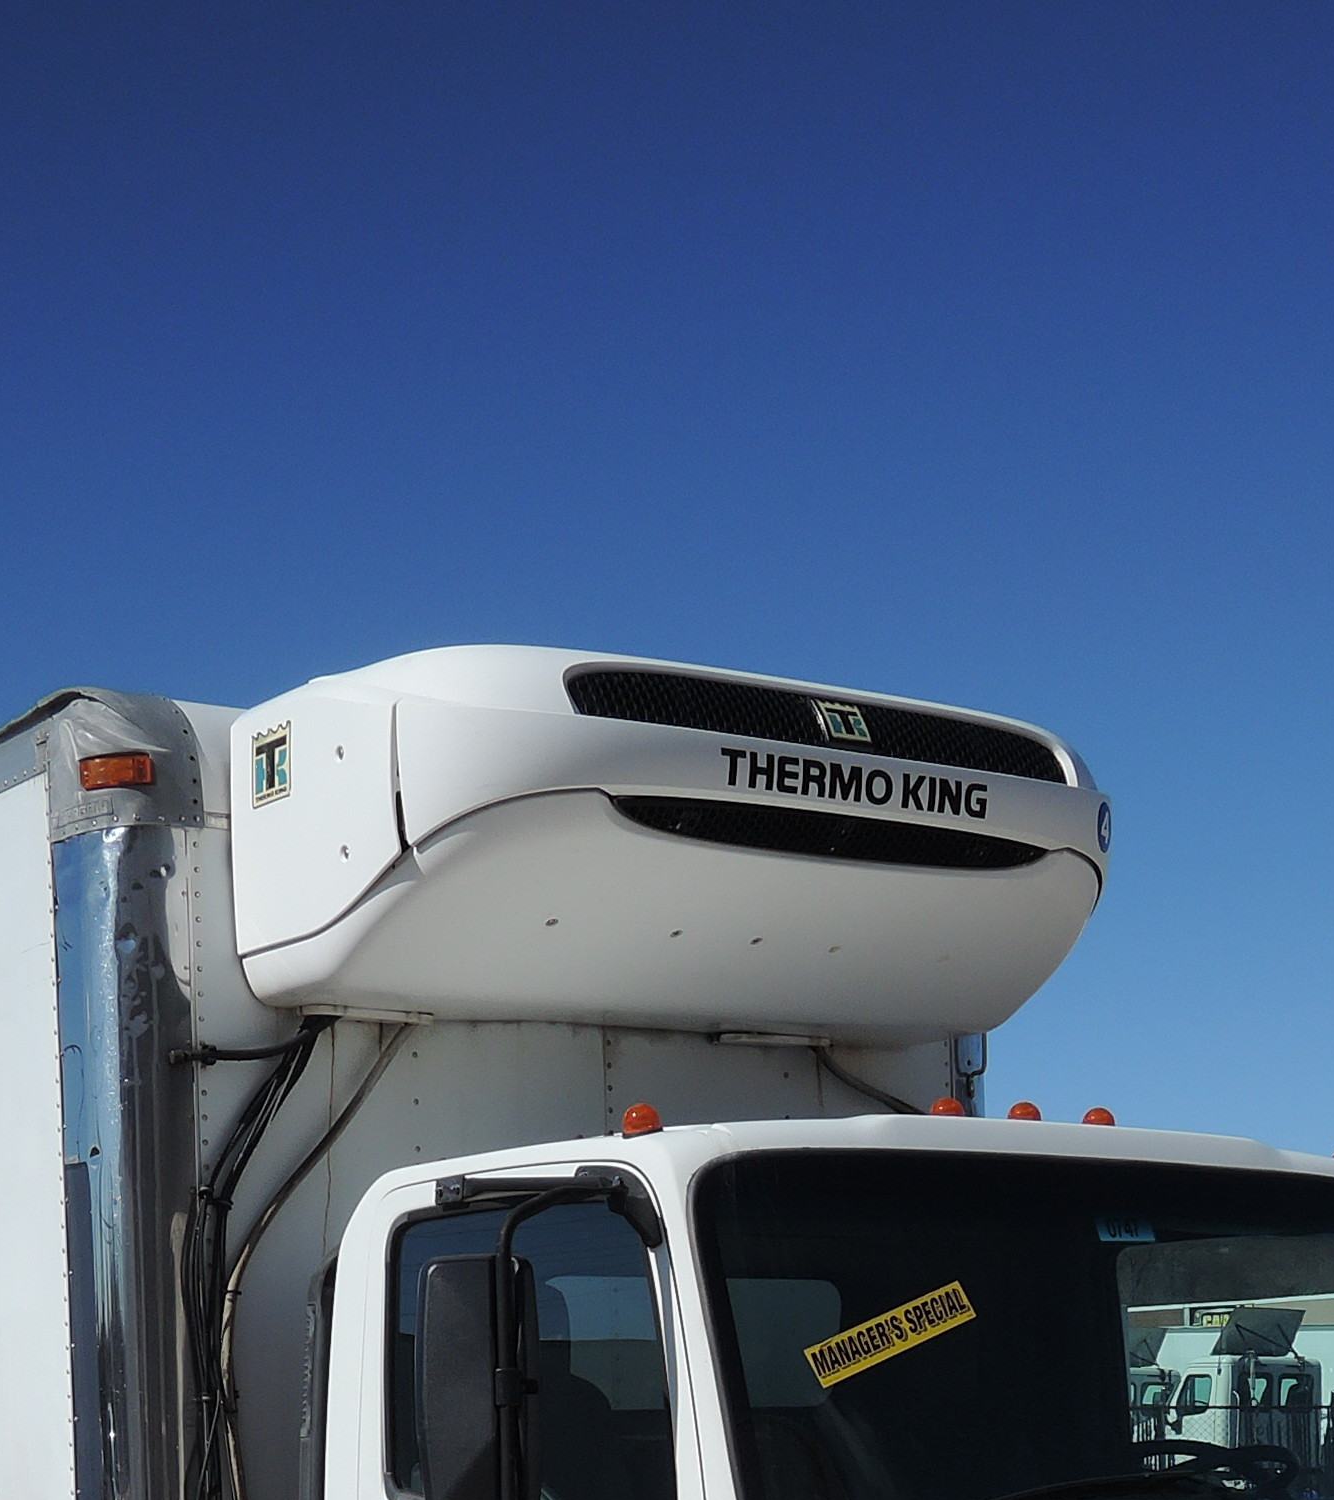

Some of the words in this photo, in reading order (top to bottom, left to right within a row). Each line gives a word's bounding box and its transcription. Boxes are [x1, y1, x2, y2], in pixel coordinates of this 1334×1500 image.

[720, 747, 894, 806] THERMO
[901, 773, 988, 819] KING
[1100, 811, 1109, 844] 4
[811, 1314, 905, 1377] MANAGER'S
[904, 1288, 968, 1334] SPECIAL
